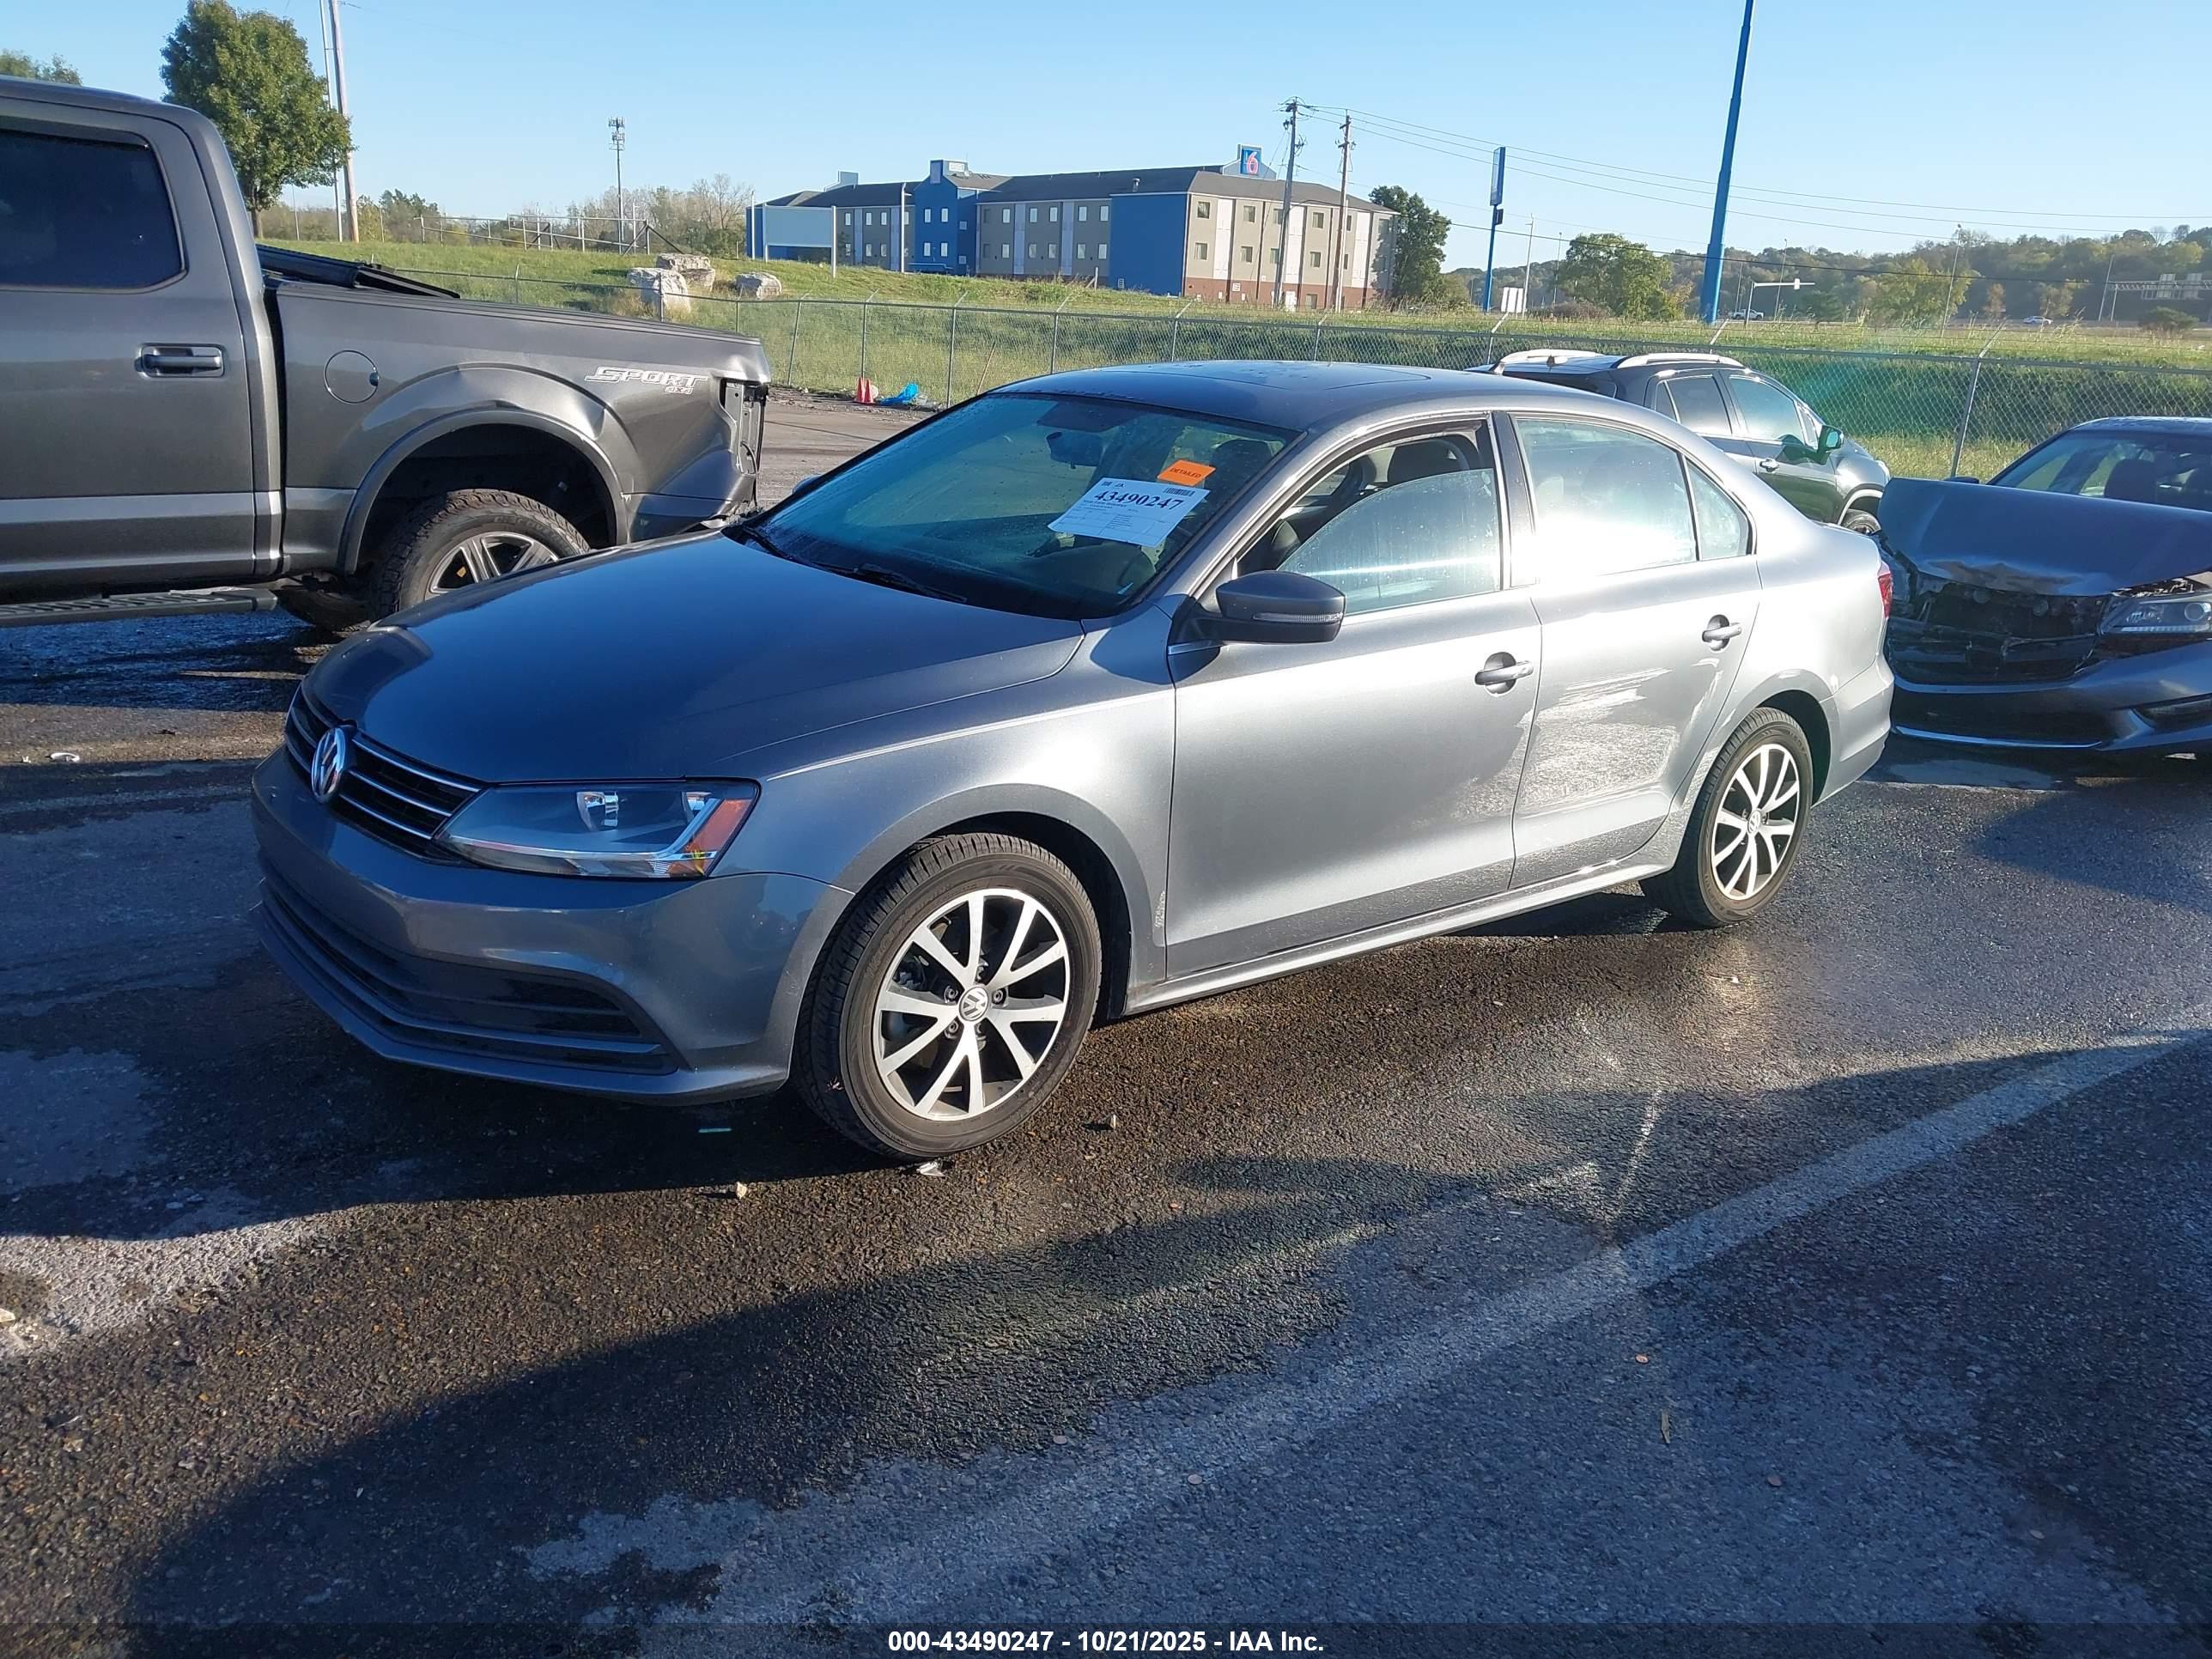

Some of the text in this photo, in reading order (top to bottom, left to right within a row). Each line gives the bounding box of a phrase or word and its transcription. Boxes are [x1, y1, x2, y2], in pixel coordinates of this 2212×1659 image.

[1246, 151, 1259, 175] 6
[584, 367, 708, 387] SPORT
[1093, 490, 1185, 510] 43490247
